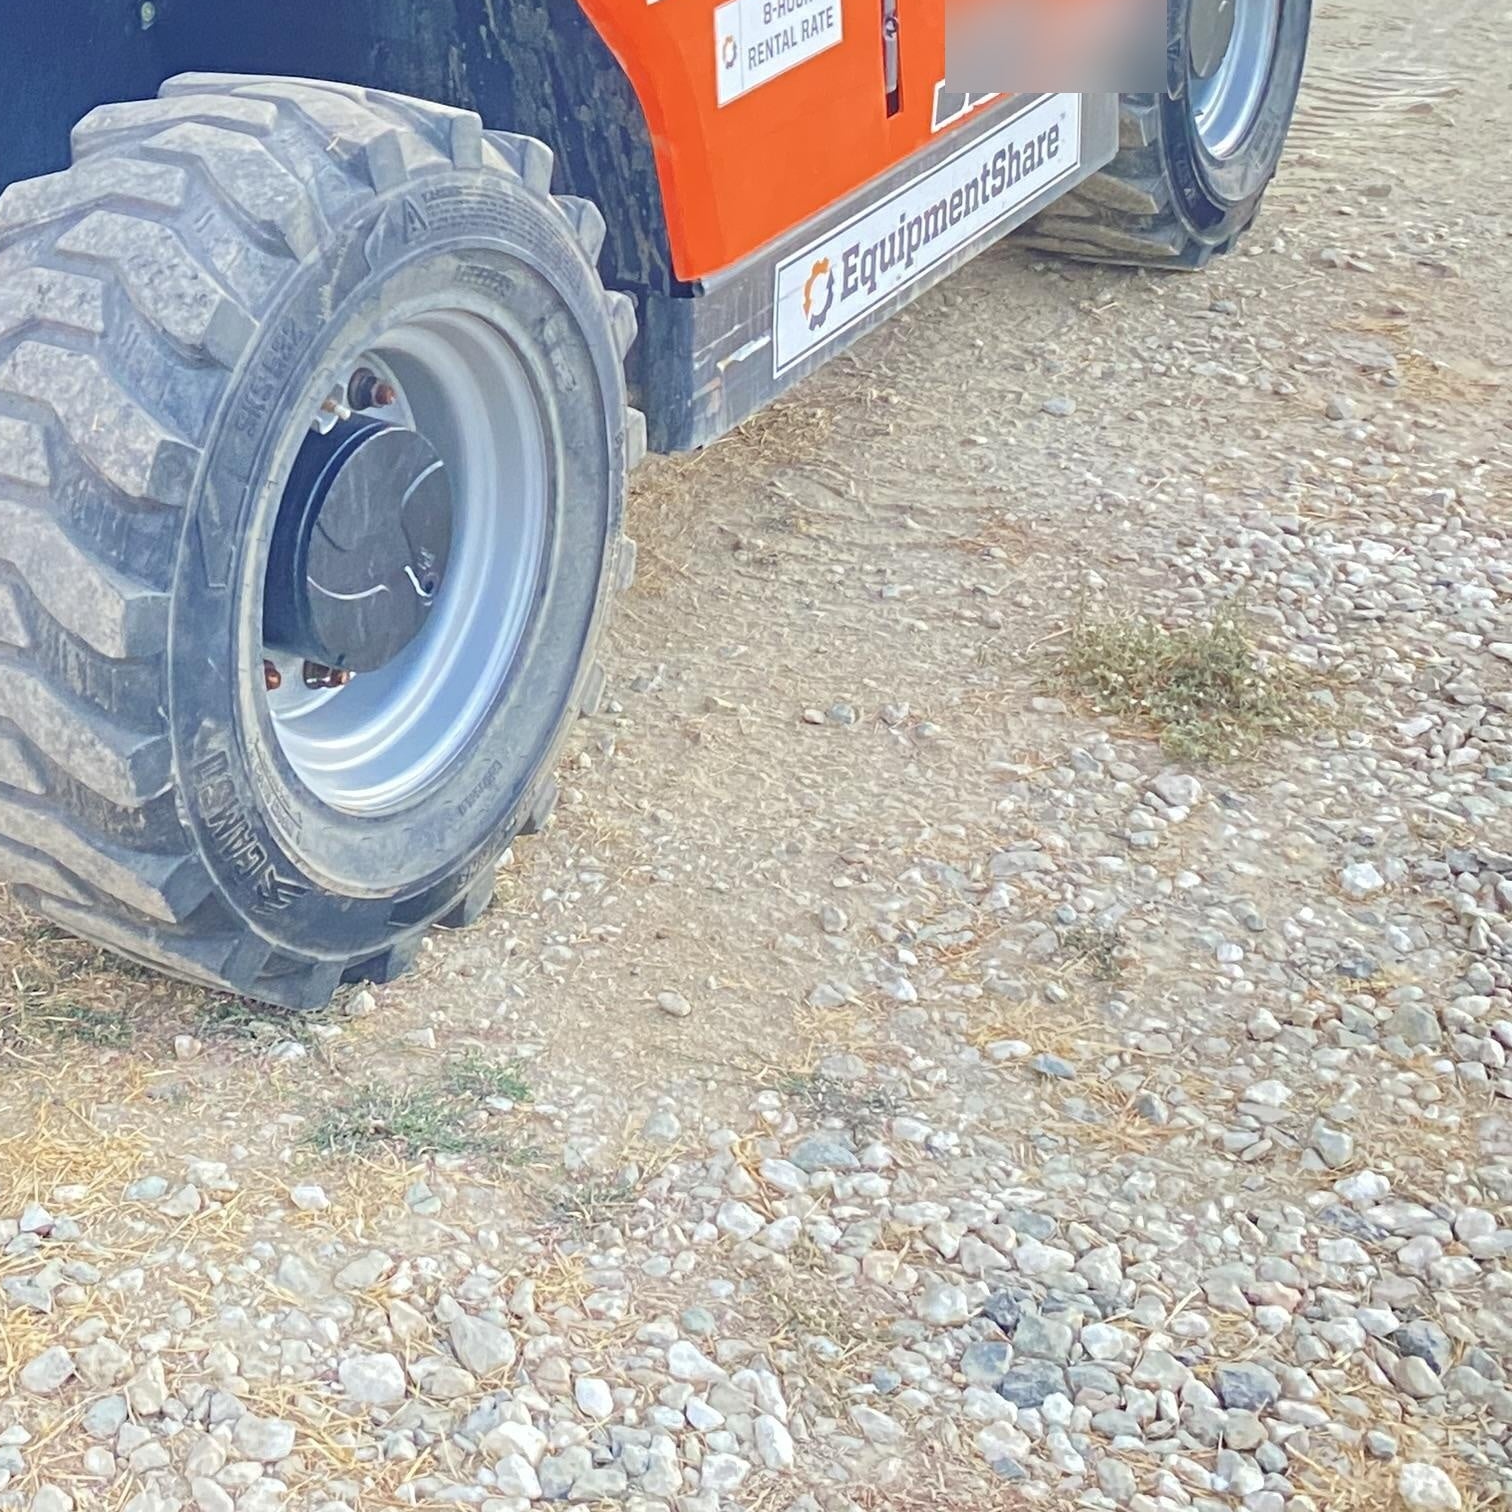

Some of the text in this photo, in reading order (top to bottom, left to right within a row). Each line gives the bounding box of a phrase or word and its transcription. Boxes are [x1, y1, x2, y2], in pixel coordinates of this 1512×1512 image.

[747, 6, 834, 71] RENTAL RATE
[840, 122, 1061, 302] EquipmentShare
